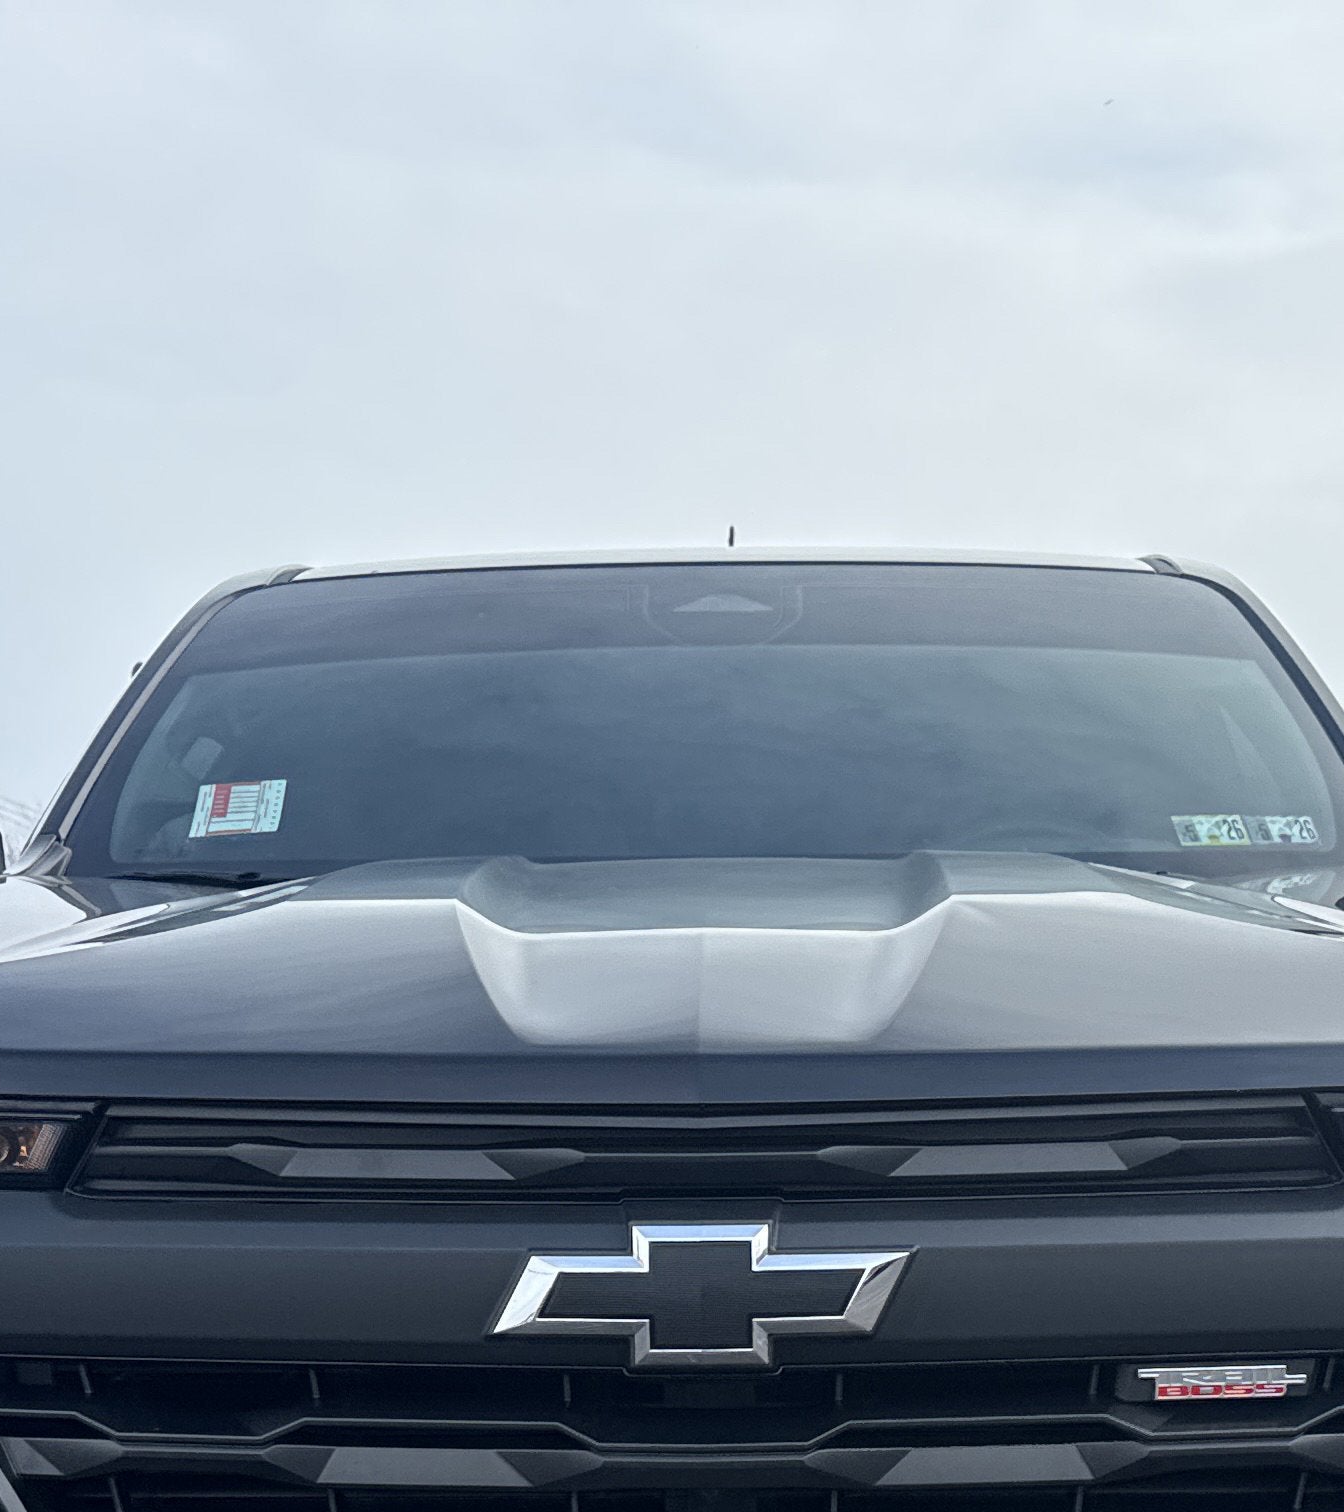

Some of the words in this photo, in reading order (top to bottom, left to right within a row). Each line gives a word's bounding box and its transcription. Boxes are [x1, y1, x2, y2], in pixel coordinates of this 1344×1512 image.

[1222, 819, 1245, 840] 26
[1294, 819, 1317, 840] 26
[1155, 1384, 1288, 1401] BOSS
